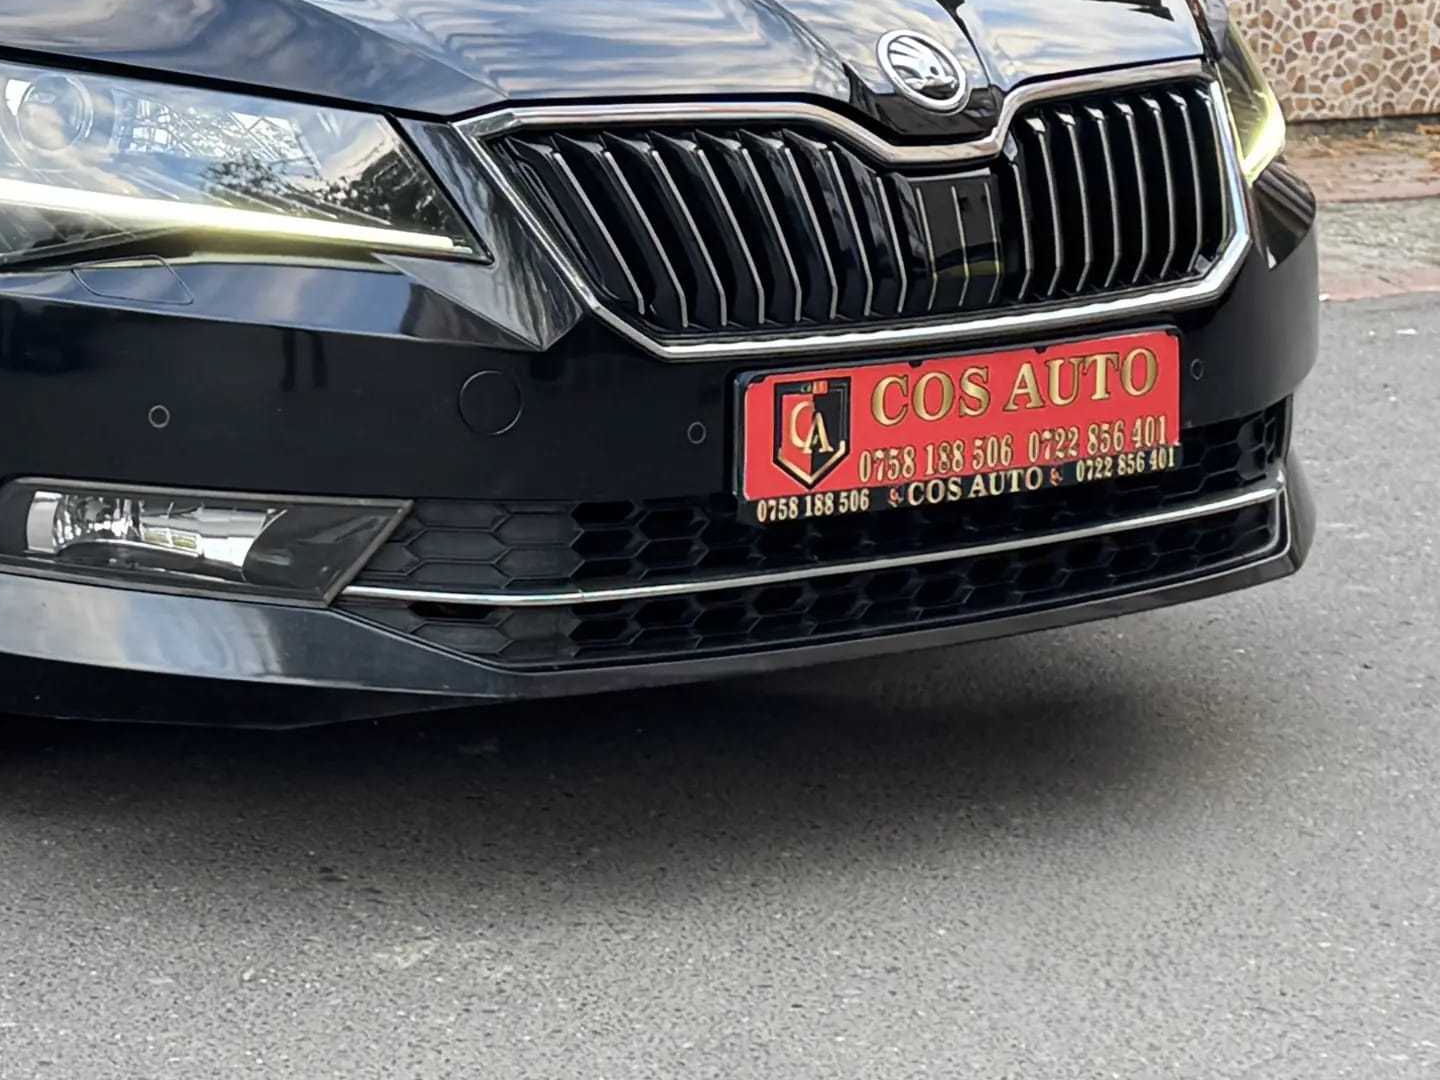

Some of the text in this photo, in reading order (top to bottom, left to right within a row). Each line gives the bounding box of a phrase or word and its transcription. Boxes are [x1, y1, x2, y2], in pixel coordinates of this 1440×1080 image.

[871, 347, 1159, 426] COS AUTO
[757, 446, 1176, 522] 0758 188 506 COS AUTO 0722 856 401
[859, 415, 1167, 483] 0758 188 506 0722 856 401
